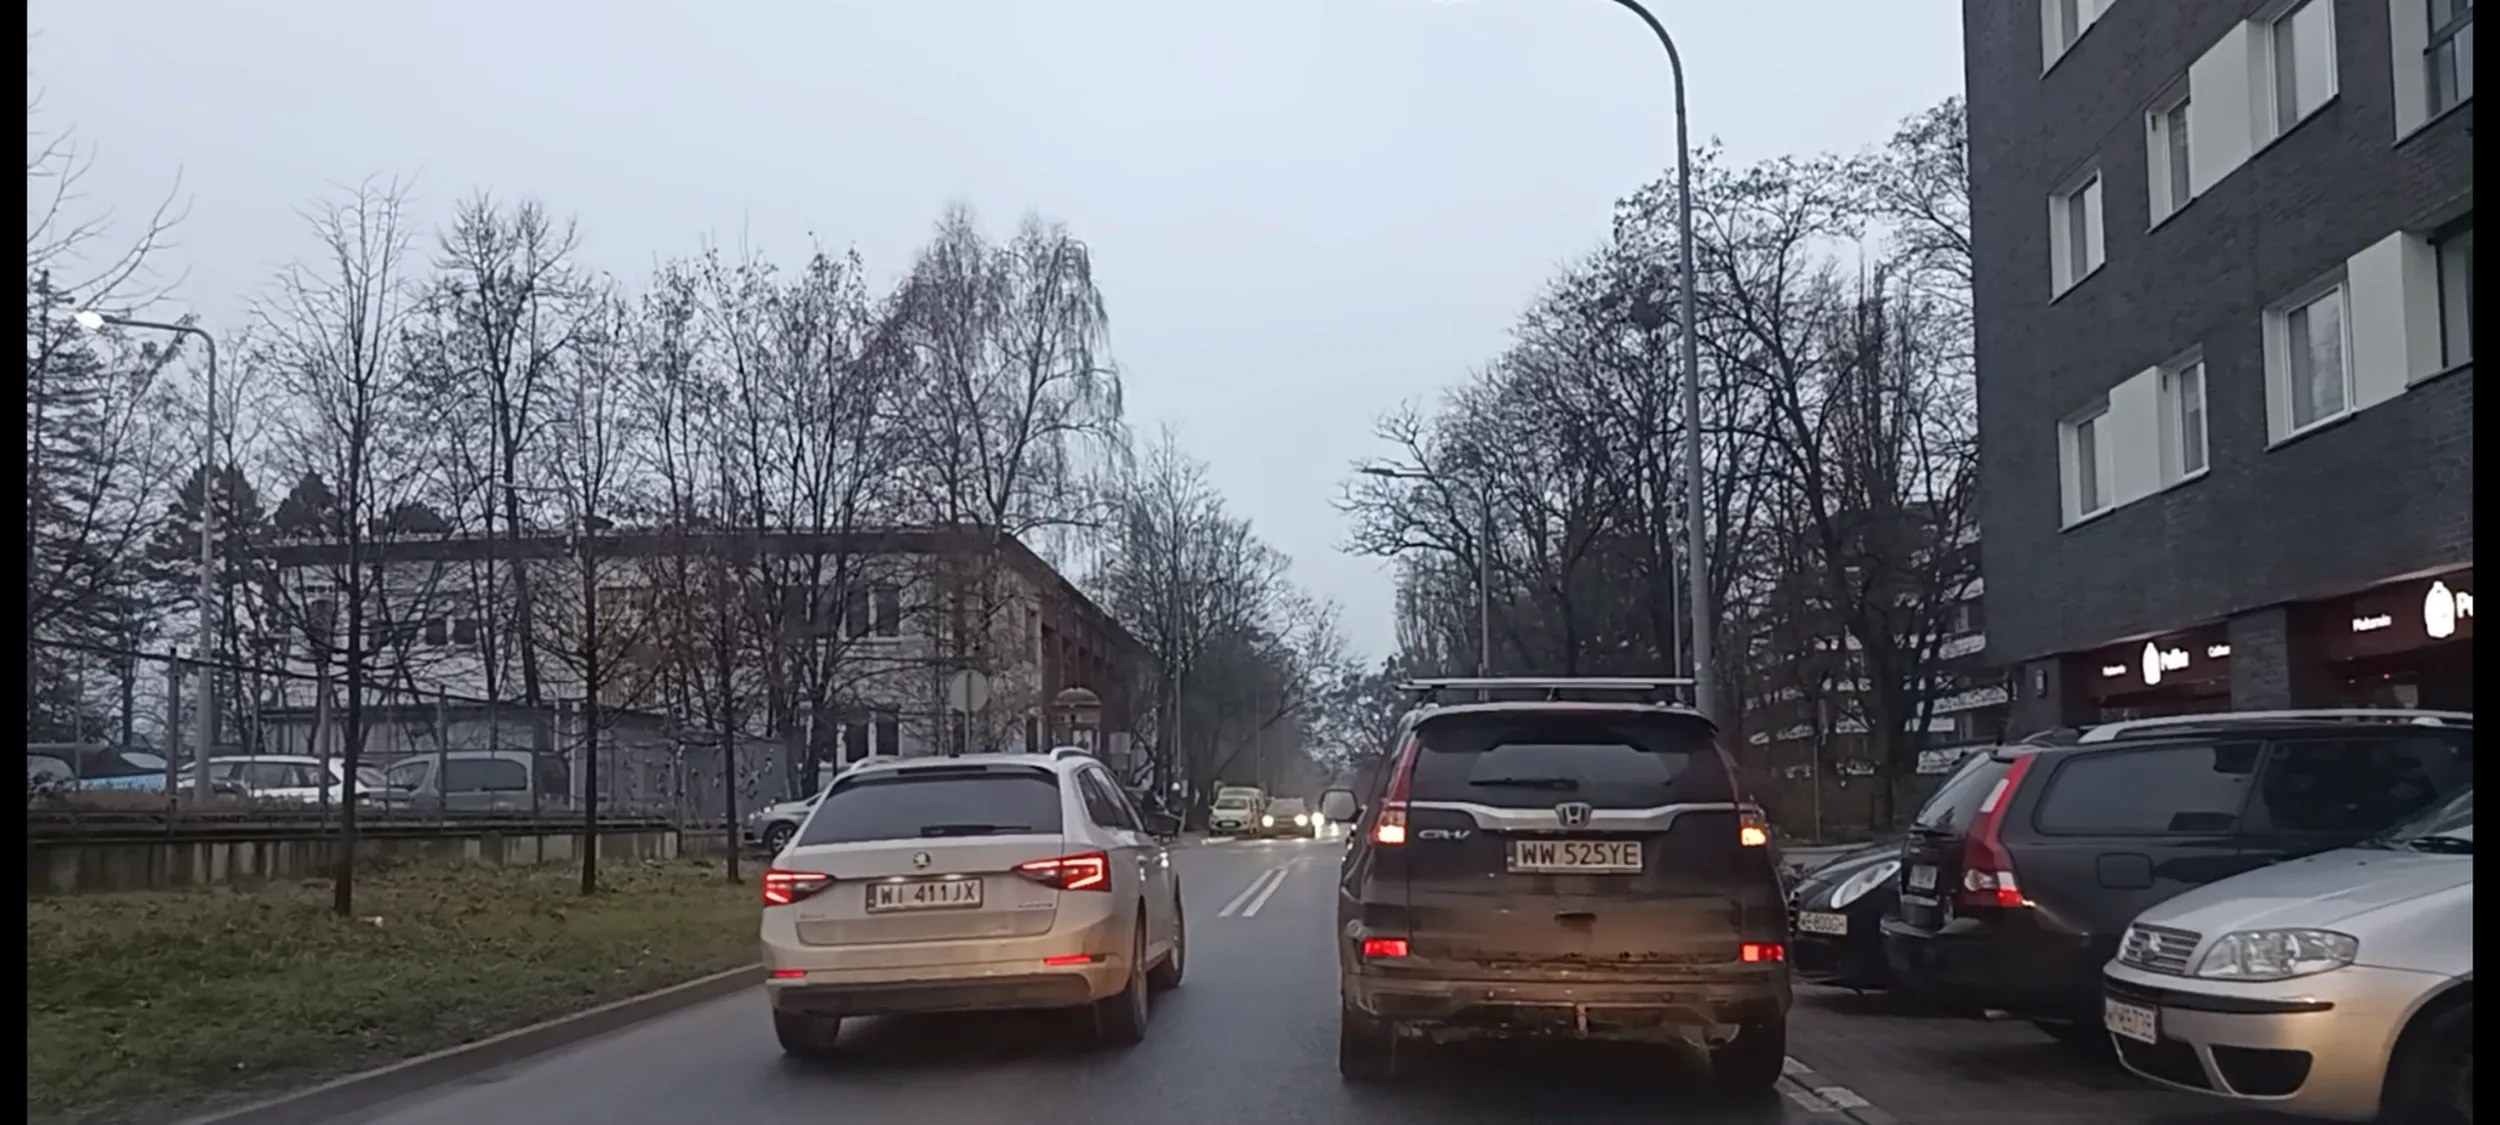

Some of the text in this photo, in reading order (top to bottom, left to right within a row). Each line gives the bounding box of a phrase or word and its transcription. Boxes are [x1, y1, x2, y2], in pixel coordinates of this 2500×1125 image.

[1521, 843, 1639, 866] WW 525YE
[880, 881, 976, 906] WI 411JX
